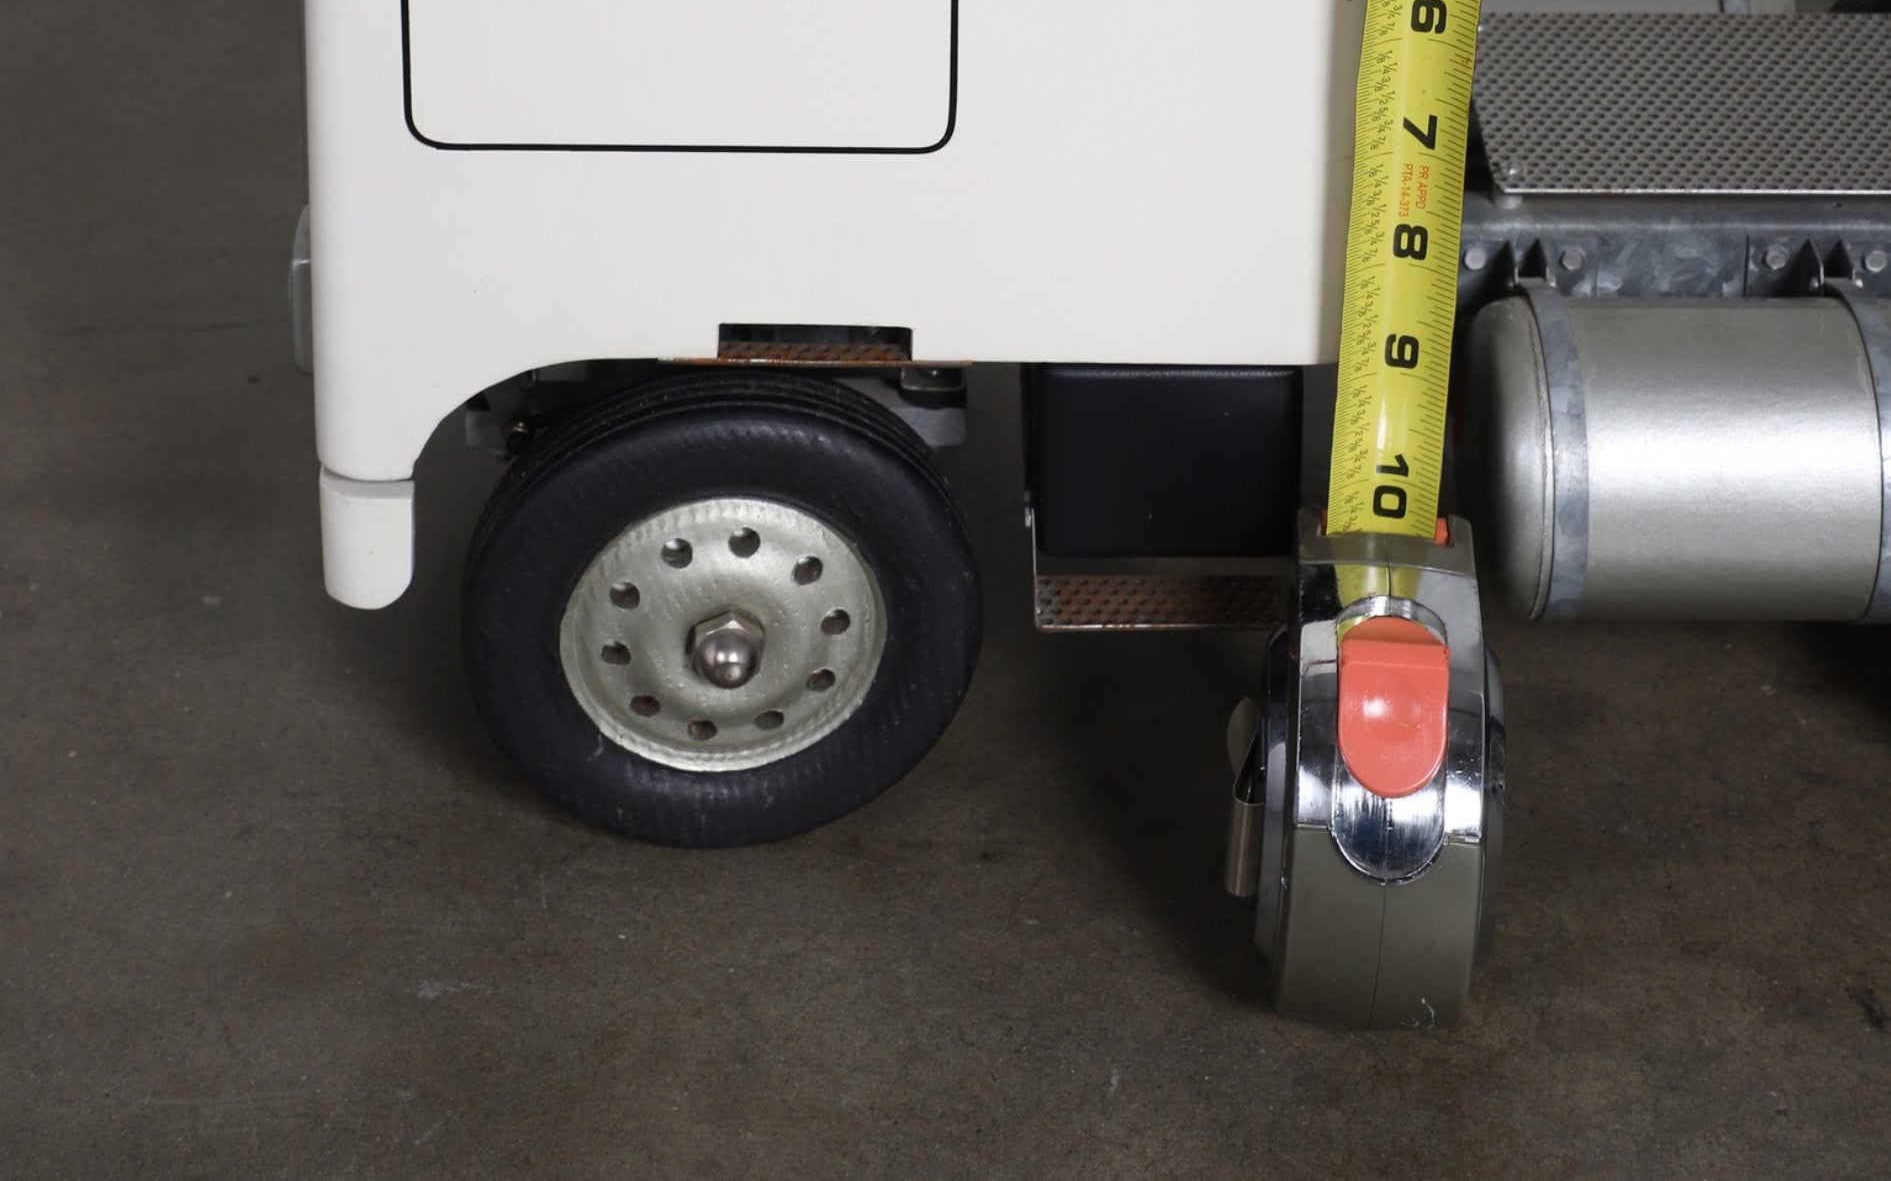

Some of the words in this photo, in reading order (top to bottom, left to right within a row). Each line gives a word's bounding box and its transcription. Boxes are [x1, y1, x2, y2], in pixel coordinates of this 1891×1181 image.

[1402, 114, 1438, 151] 7
[1392, 223, 1429, 261] 8
[1384, 333, 1419, 369] 9
[1372, 453, 1410, 520] 10
